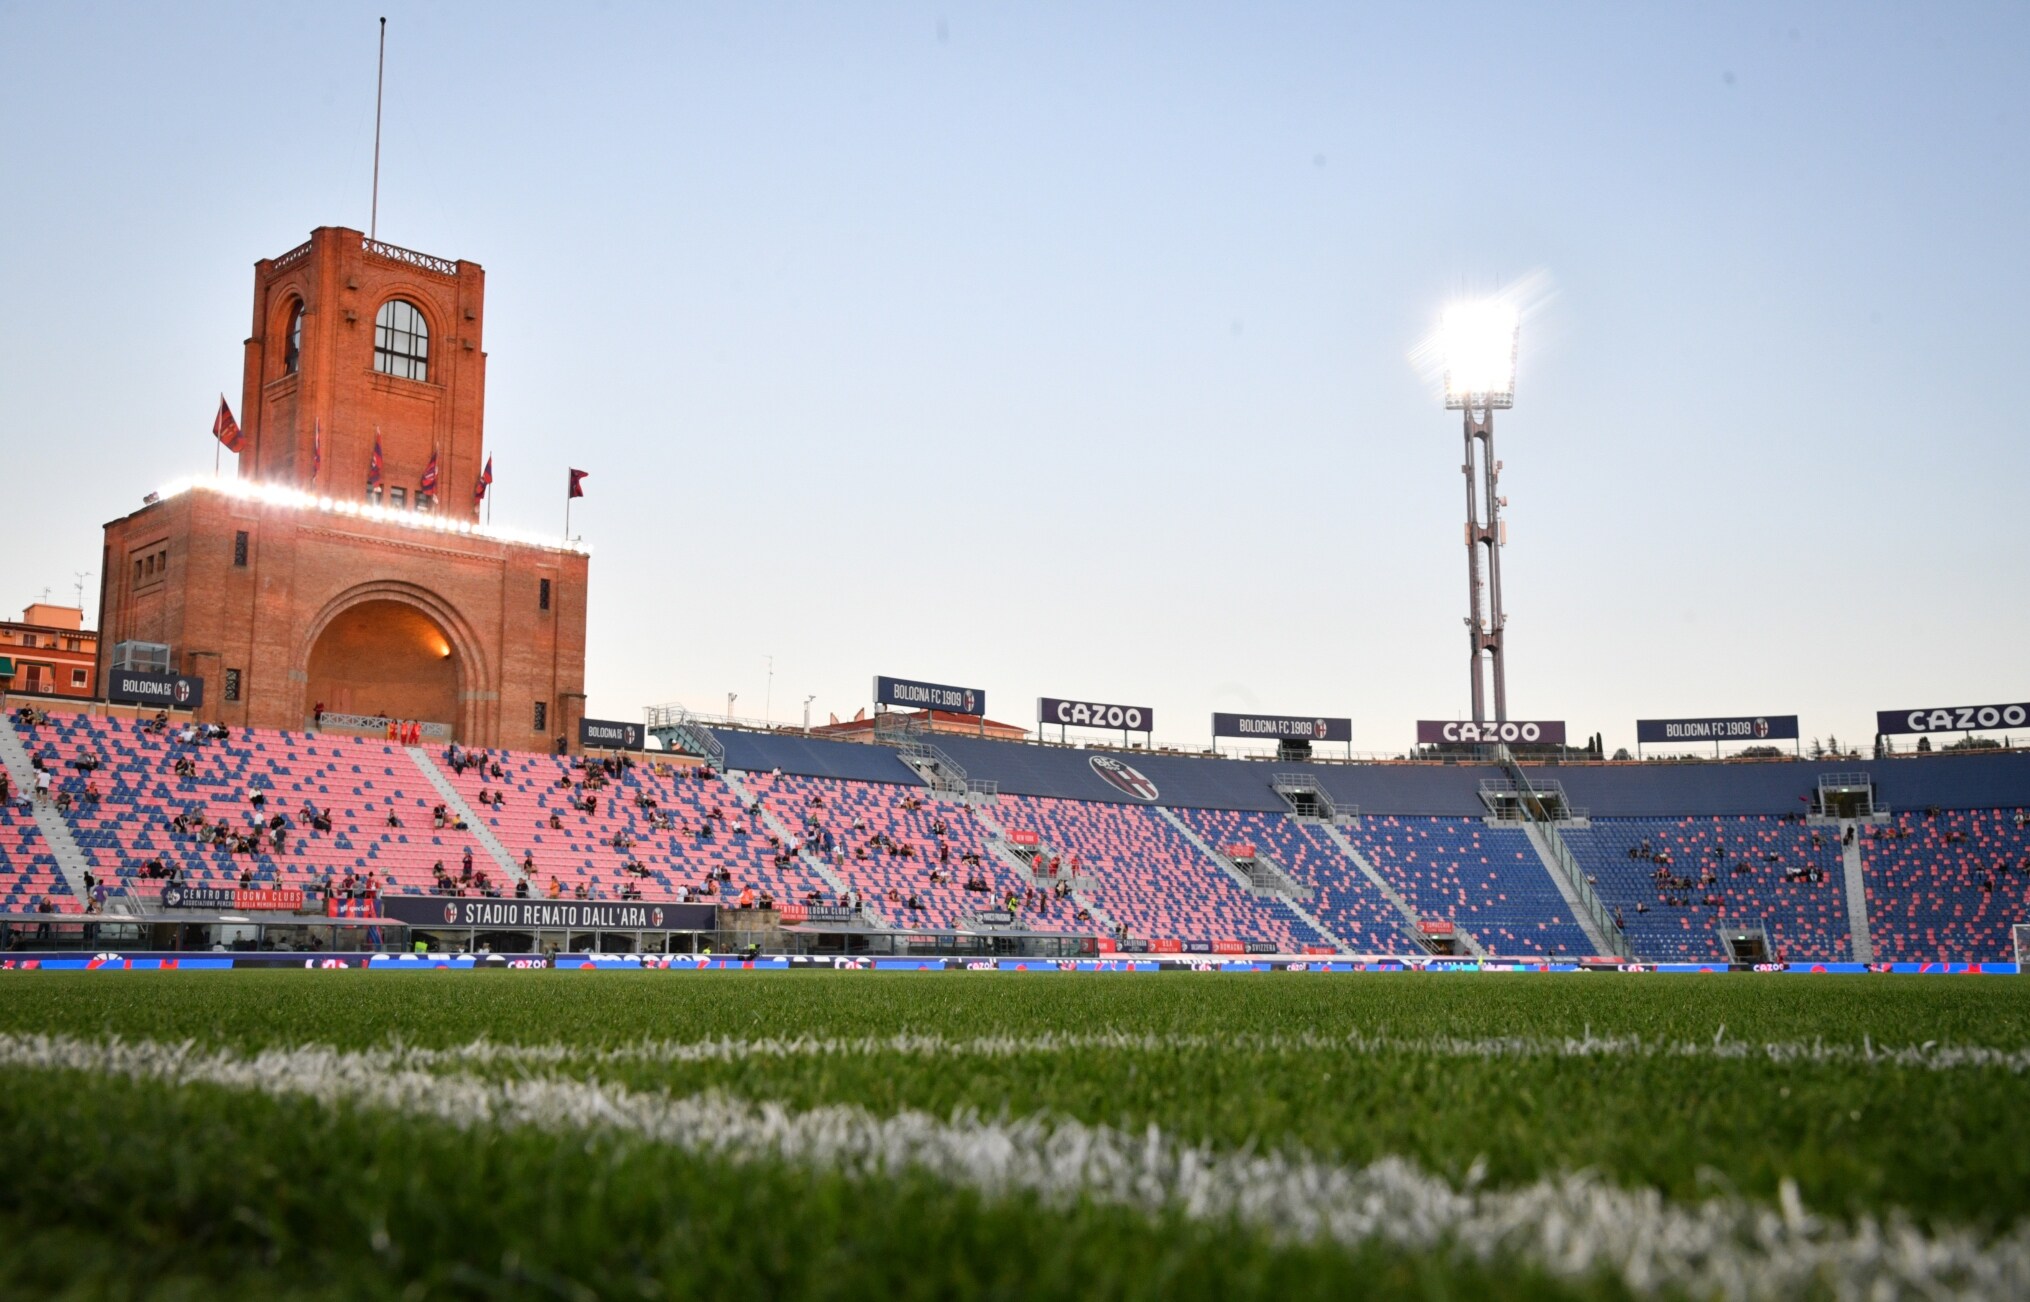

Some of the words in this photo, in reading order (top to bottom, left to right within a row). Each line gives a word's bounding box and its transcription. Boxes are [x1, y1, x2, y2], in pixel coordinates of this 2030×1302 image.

[122, 679, 163, 695] BOLOGNA
[893, 683, 930, 703] BOLOGNA
[931, 688, 941, 704] FC
[942, 690, 962, 707] 1909
[1057, 701, 1142, 728] CAZOO
[1907, 705, 2027, 731] CAZOO
[588, 725, 617, 739] BOLOGNA
[1240, 718, 1277, 733] BOLOGNA
[1279, 720, 1289, 734] FC
[1290, 721, 1312, 735] 1909
[1442, 722, 1541, 742] CAZOO
[1666, 722, 1711, 737] BOLOGNA
[1712, 721, 1724, 736] FC
[1726, 721, 1751, 735] 1909
[183, 889, 220, 900] CENTRO
[224, 890, 267, 901] BOLOGNA
[272, 891, 301, 902] CLUBS
[465, 903, 518, 925] STADIO
[523, 905, 577, 926] RENATO
[582, 906, 647, 927] DALL'ARA
[801, 906, 829, 915] BOLOGNA
[831, 907, 850, 915] CLUBS
[1252, 943, 1276, 952] SVIZZERA
